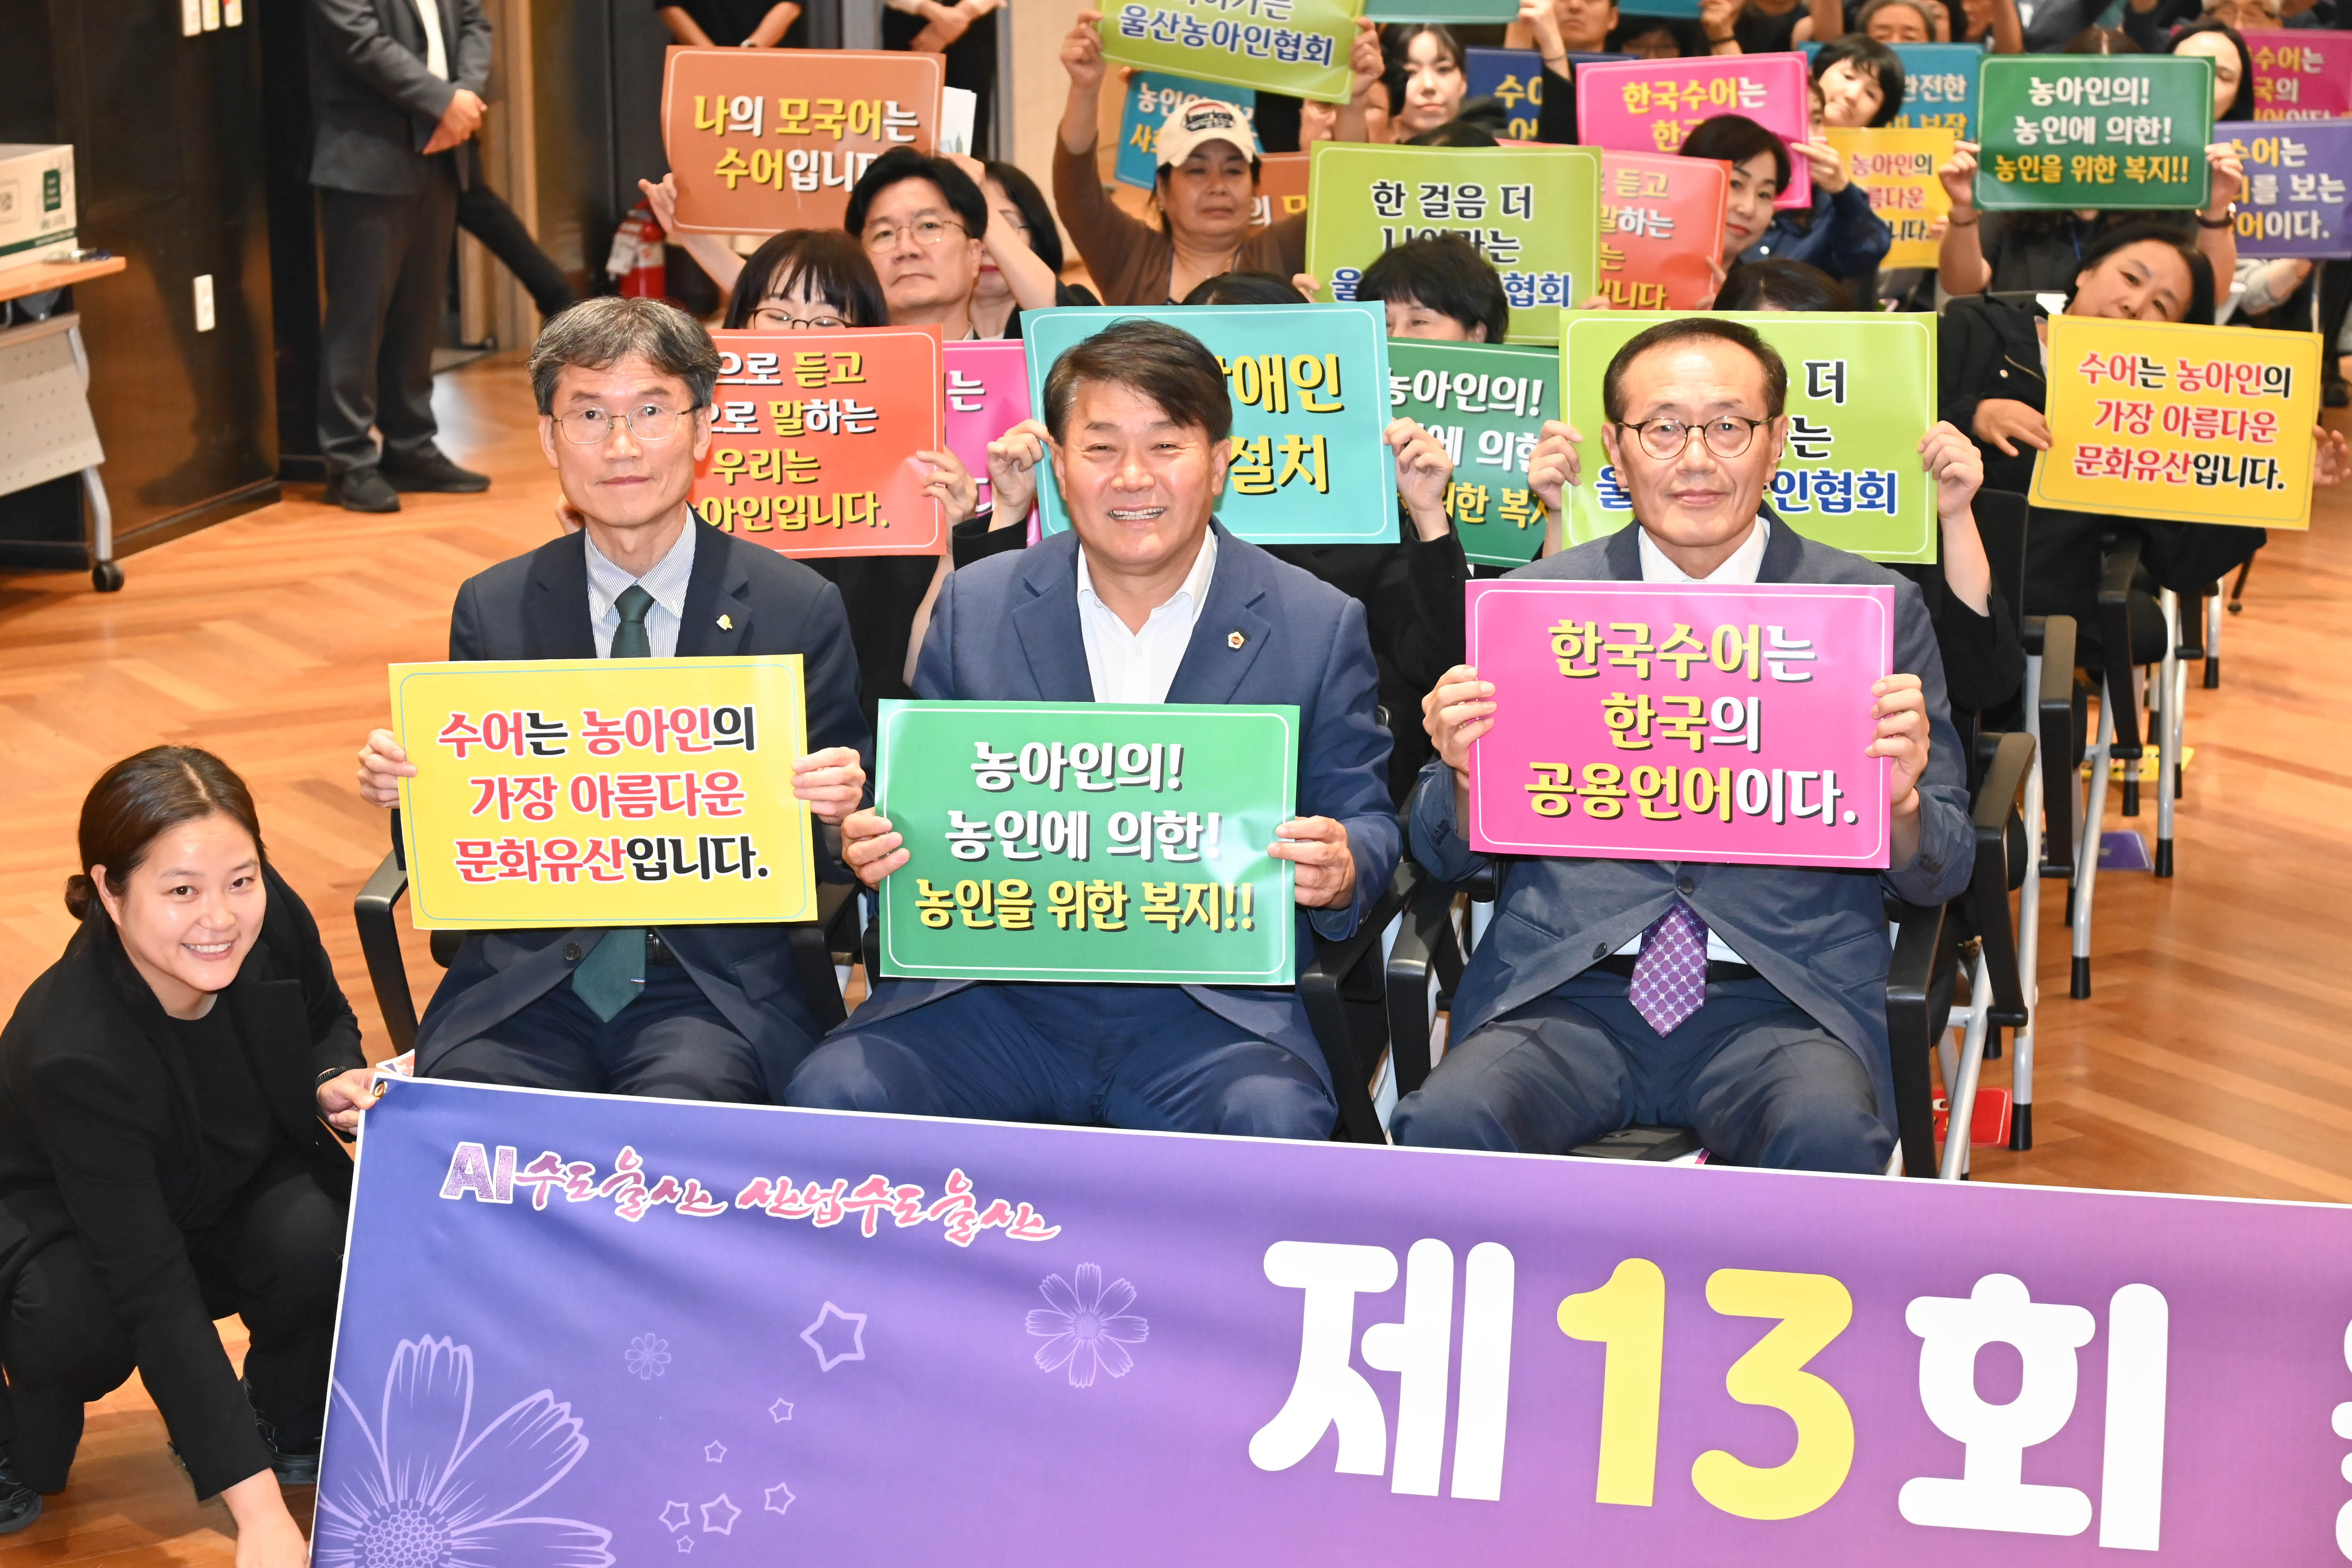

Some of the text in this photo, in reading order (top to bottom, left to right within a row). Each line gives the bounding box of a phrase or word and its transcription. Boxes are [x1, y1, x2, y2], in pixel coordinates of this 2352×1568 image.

[1120, 5, 1333, 66] 울산농아인협회
[1622, 77, 1767, 114] 한국수어는
[2029, 76, 2150, 106] 농아인의!
[695, 95, 919, 142] 나의 모국어는
[2014, 115, 2173, 145] 농인에 의한!
[1613, 168, 1669, 199] 듣고
[1851, 153, 1933, 177] 농아인의
[1994, 154, 2189, 184] 농인을 위한 복지!!
[1372, 180, 1531, 220] 한 걸음 더
[2288, 173, 2347, 204] 보는
[791, 351, 866, 388] 듣고
[1215, 353, 1345, 414] 애인
[1805, 360, 1847, 405] 더
[2079, 352, 2292, 399] 수어는 농아인의
[767, 398, 878, 437] 말하는
[2094, 400, 2278, 443] 가장 아름다운
[711, 448, 820, 485] 우리는
[2074, 445, 2285, 490] 문화유산입니다.
[695, 491, 890, 533] 아인입니다.
[1548, 619, 1818, 683] 한국수어는
[439, 707, 755, 758] 수어는 농아인의
[1601, 692, 1761, 753] 한국의
[970, 741, 1185, 793] 농아인의!
[470, 770, 745, 822] 가장 아름다운
[1524, 762, 1859, 826] 공용언어이다.
[945, 809, 1221, 861] 농인에 의한!
[455, 836, 769, 883] 문화유산입니다.
[915, 878, 1255, 932] 농인을 위한 복지!!
